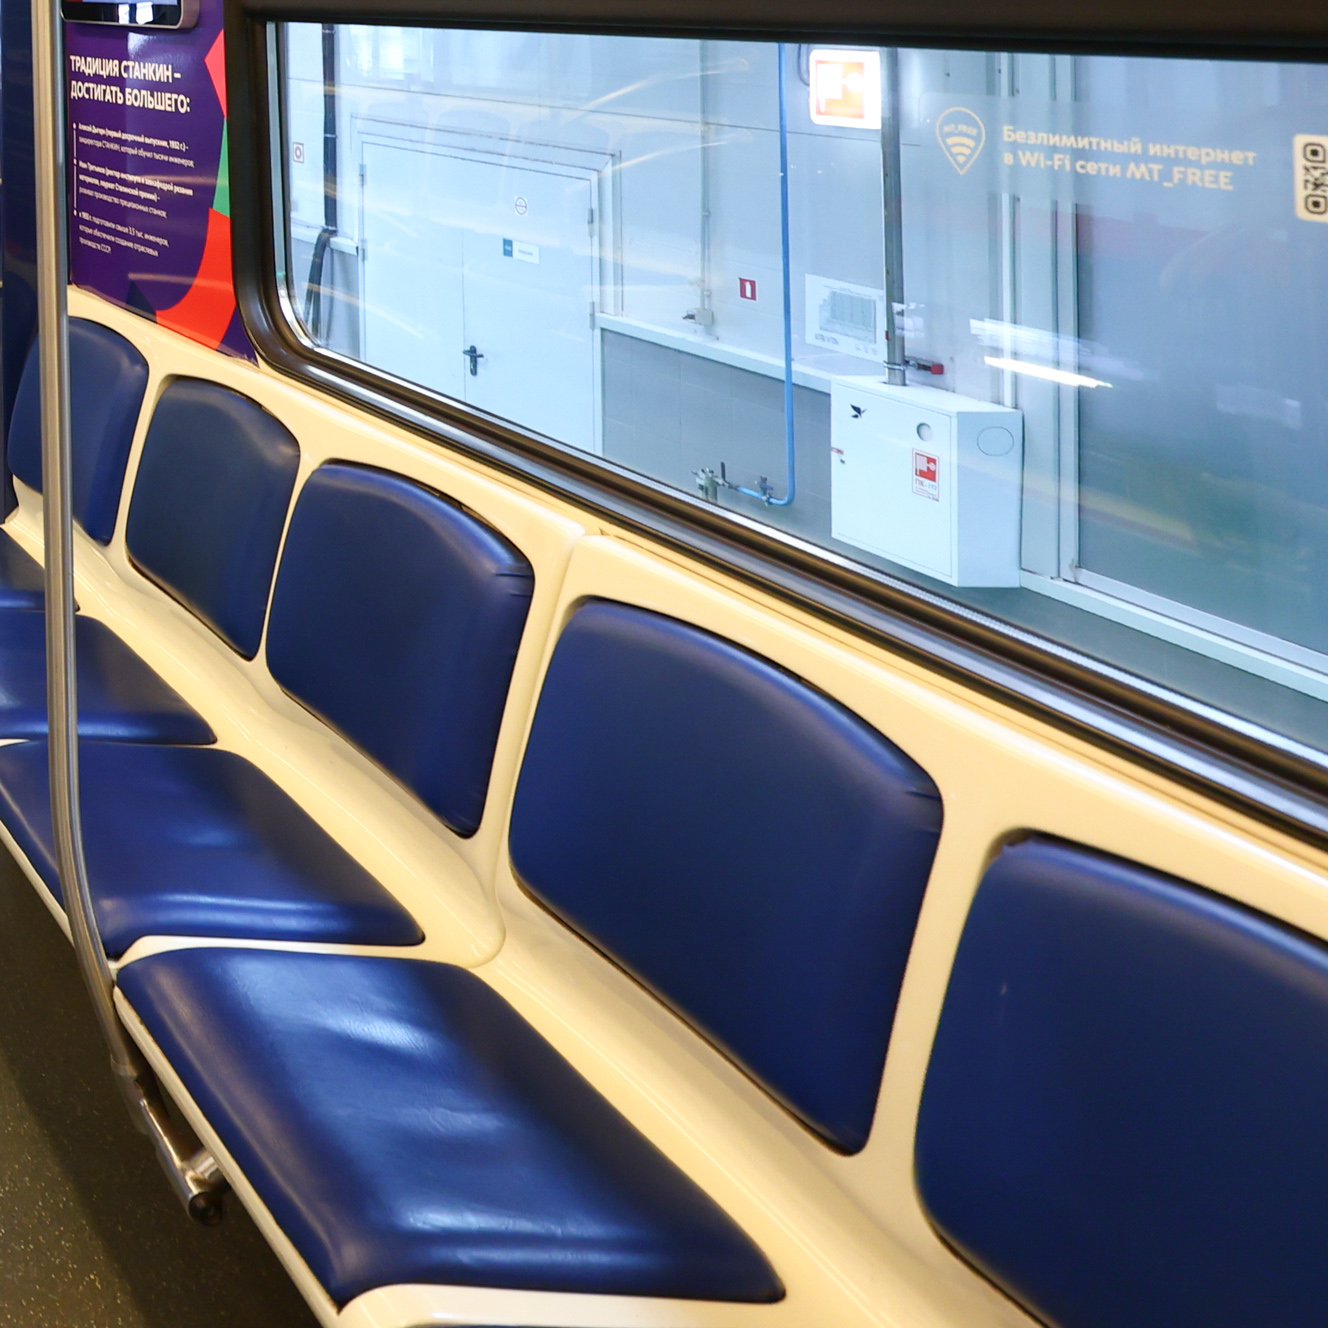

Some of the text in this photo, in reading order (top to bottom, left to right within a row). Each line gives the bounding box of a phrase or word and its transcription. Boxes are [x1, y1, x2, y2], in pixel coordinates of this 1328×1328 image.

[70, 55, 119, 79] ТРАДИЦИЯ
[121, 60, 173, 83] СТАНКИН
[70, 80, 191, 113] ДОСТИГАТЬ БОЛЬШЕГО:
[1002, 125, 1257, 167] Безлимитный интернет
[1003, 150, 1234, 190] в Wi-Fi сети MT_FREE
